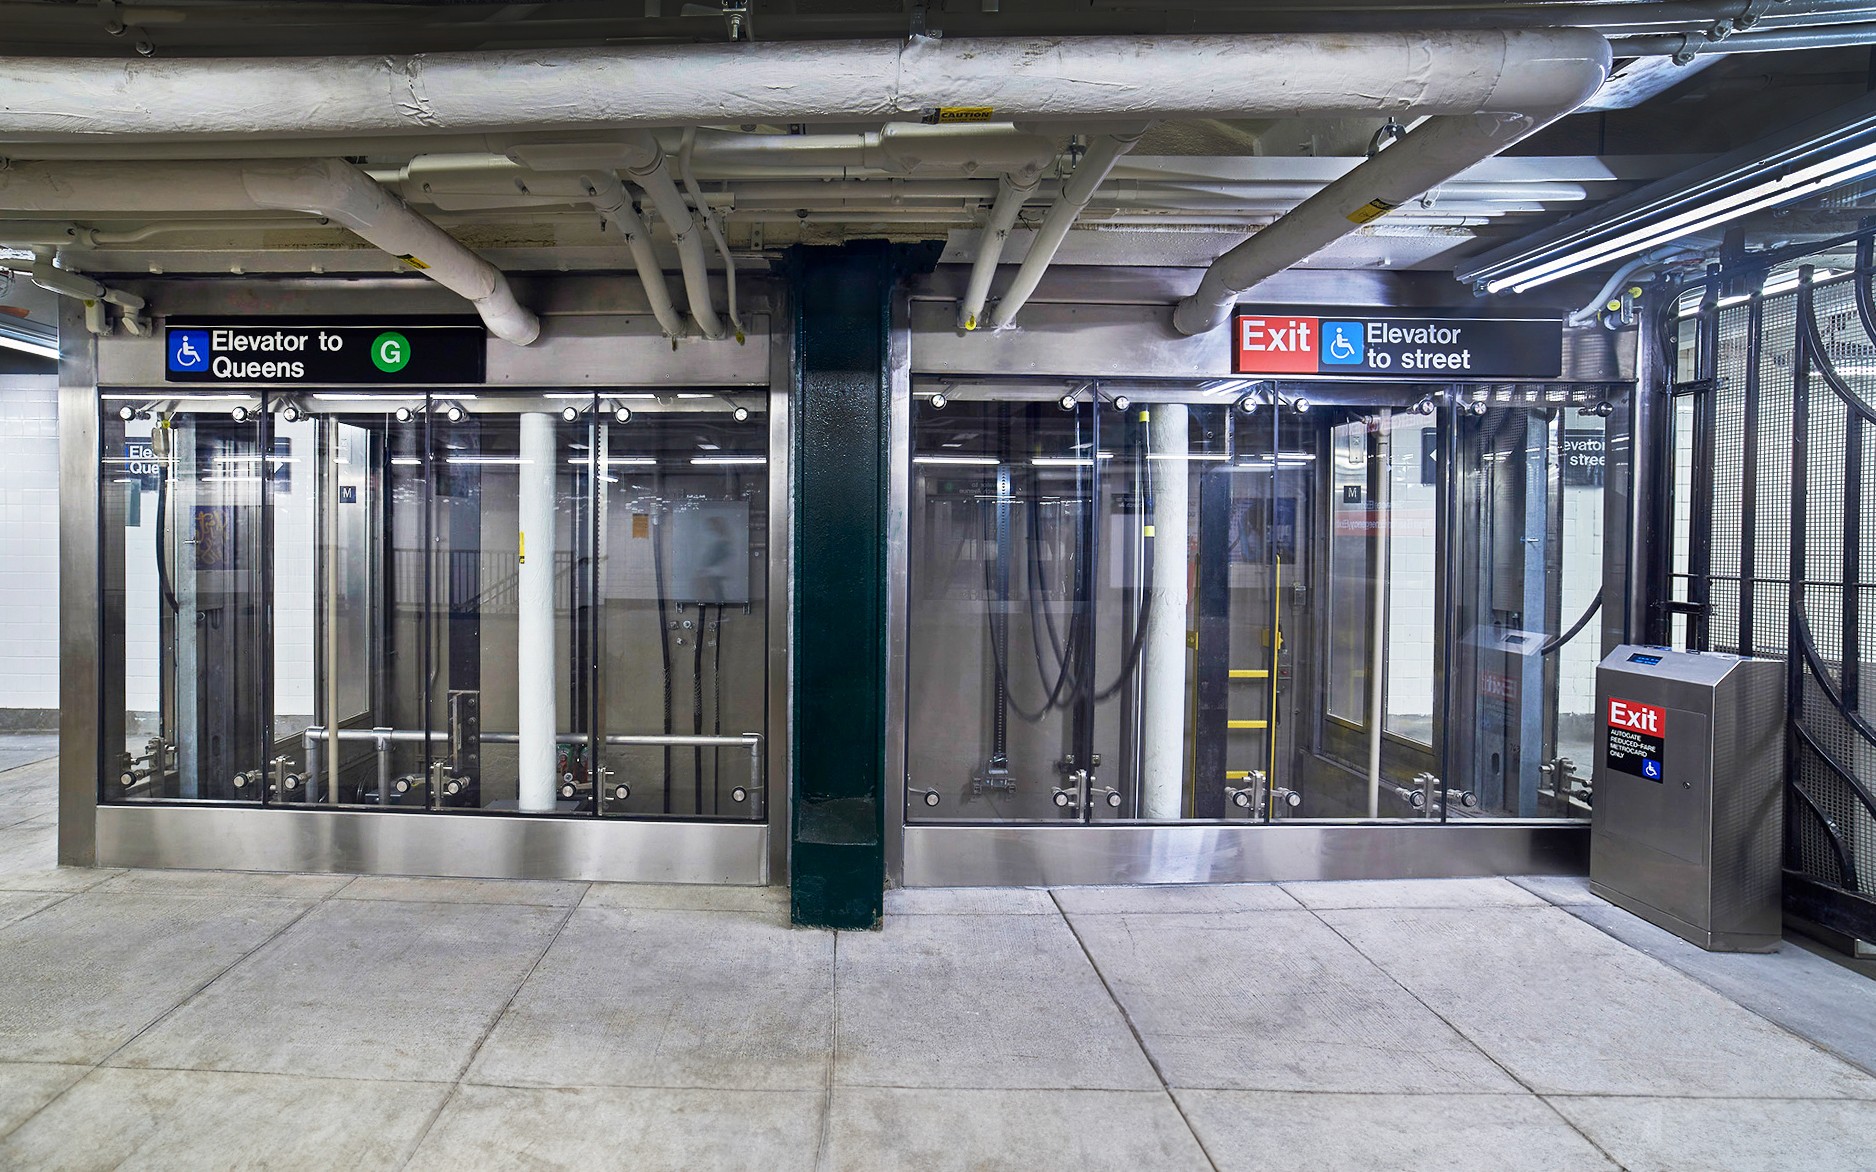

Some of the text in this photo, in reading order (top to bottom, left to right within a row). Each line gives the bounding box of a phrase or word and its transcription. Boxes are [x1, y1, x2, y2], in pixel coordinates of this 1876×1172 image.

[212, 330, 343, 352] Elevator to
[1242, 320, 1311, 352] Exit
[1367, 322, 1461, 344] Elevator
[380, 340, 401, 364] G
[1367, 349, 1471, 370] to street
[212, 356, 305, 379] Queens
[343, 487, 352, 498] M
[1348, 487, 1357, 498] M
[1610, 701, 1658, 733] Exit
[1610, 729, 1642, 741] AUTOGATE
[1610, 736, 1656, 753] REDUCED-FARE
[1609, 743, 1648, 758] METROCARD
[1609, 750, 1625, 758] ONLY
